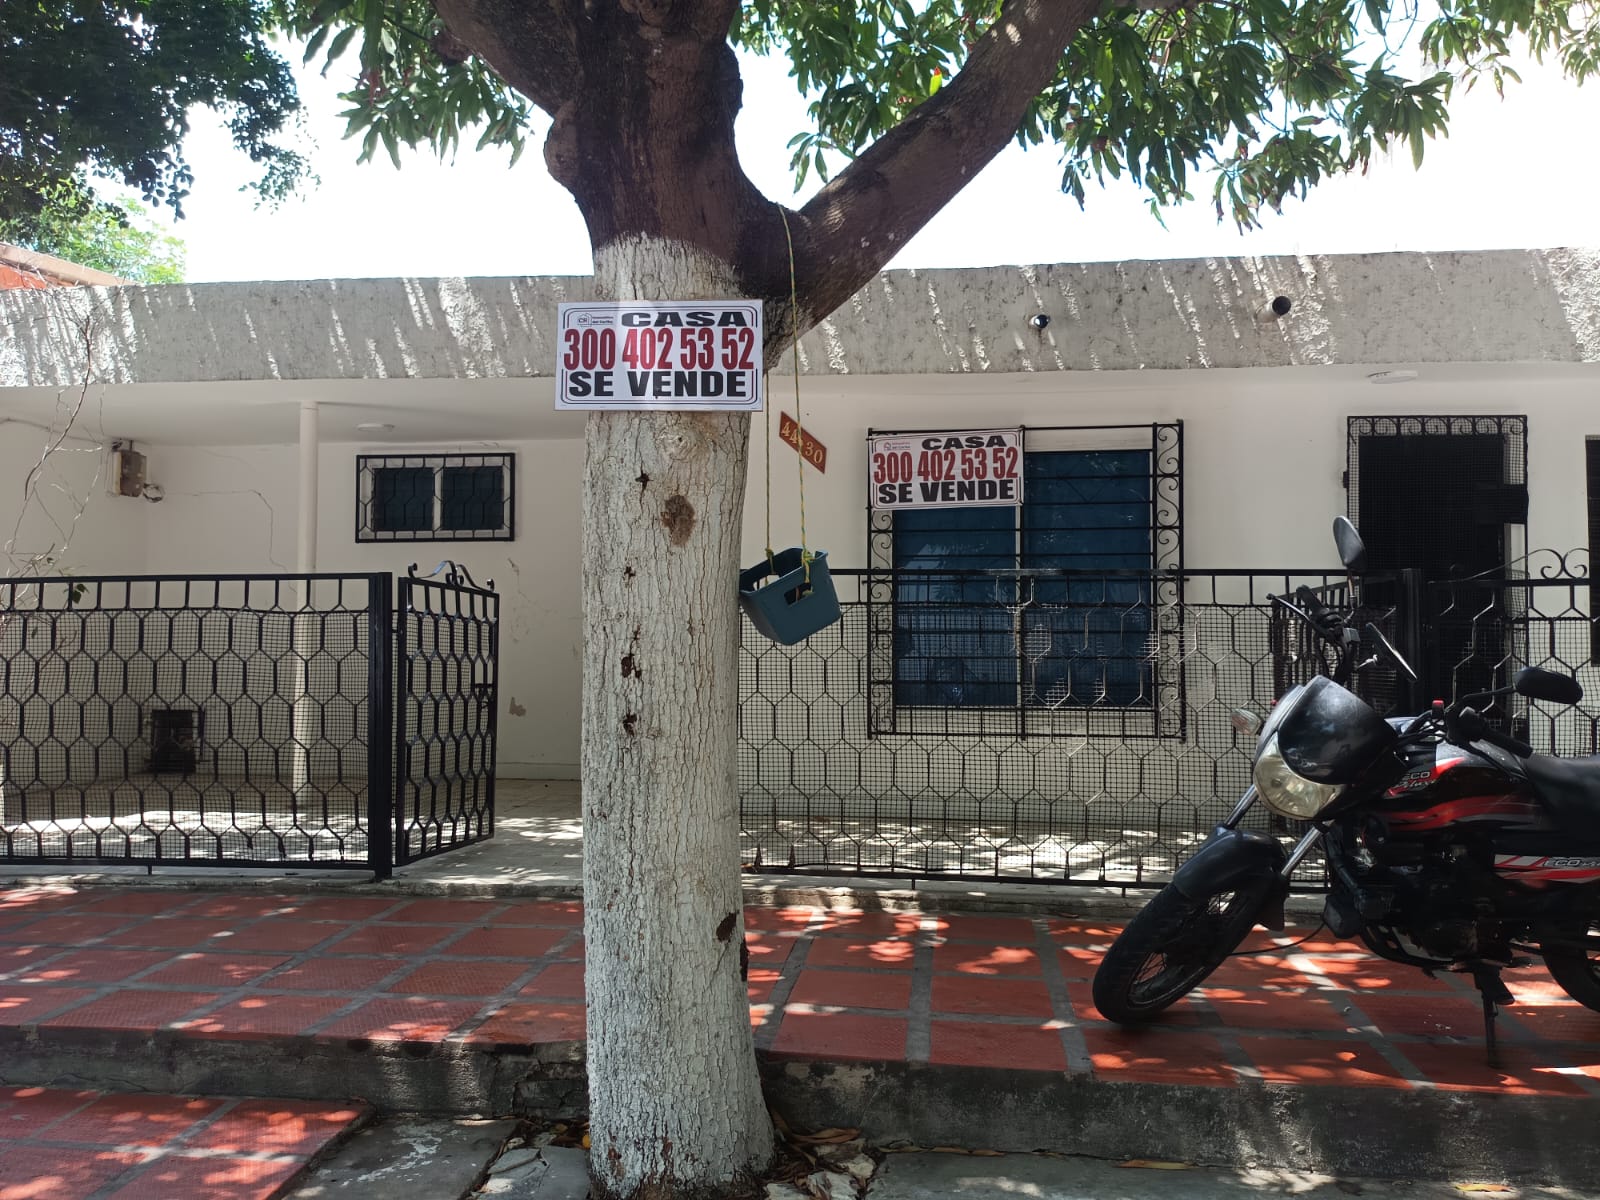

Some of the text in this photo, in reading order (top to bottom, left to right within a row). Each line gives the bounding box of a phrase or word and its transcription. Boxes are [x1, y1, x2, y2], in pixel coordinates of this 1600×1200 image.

[621, 311, 748, 327] CASA
[563, 327, 755, 370] 300 402 53 52
[568, 370, 747, 397] SE VENDE
[921, 435, 1007, 450] CASA
[873, 446, 1018, 484] 300 402 53 52
[878, 479, 1014, 504] SE VENDE
